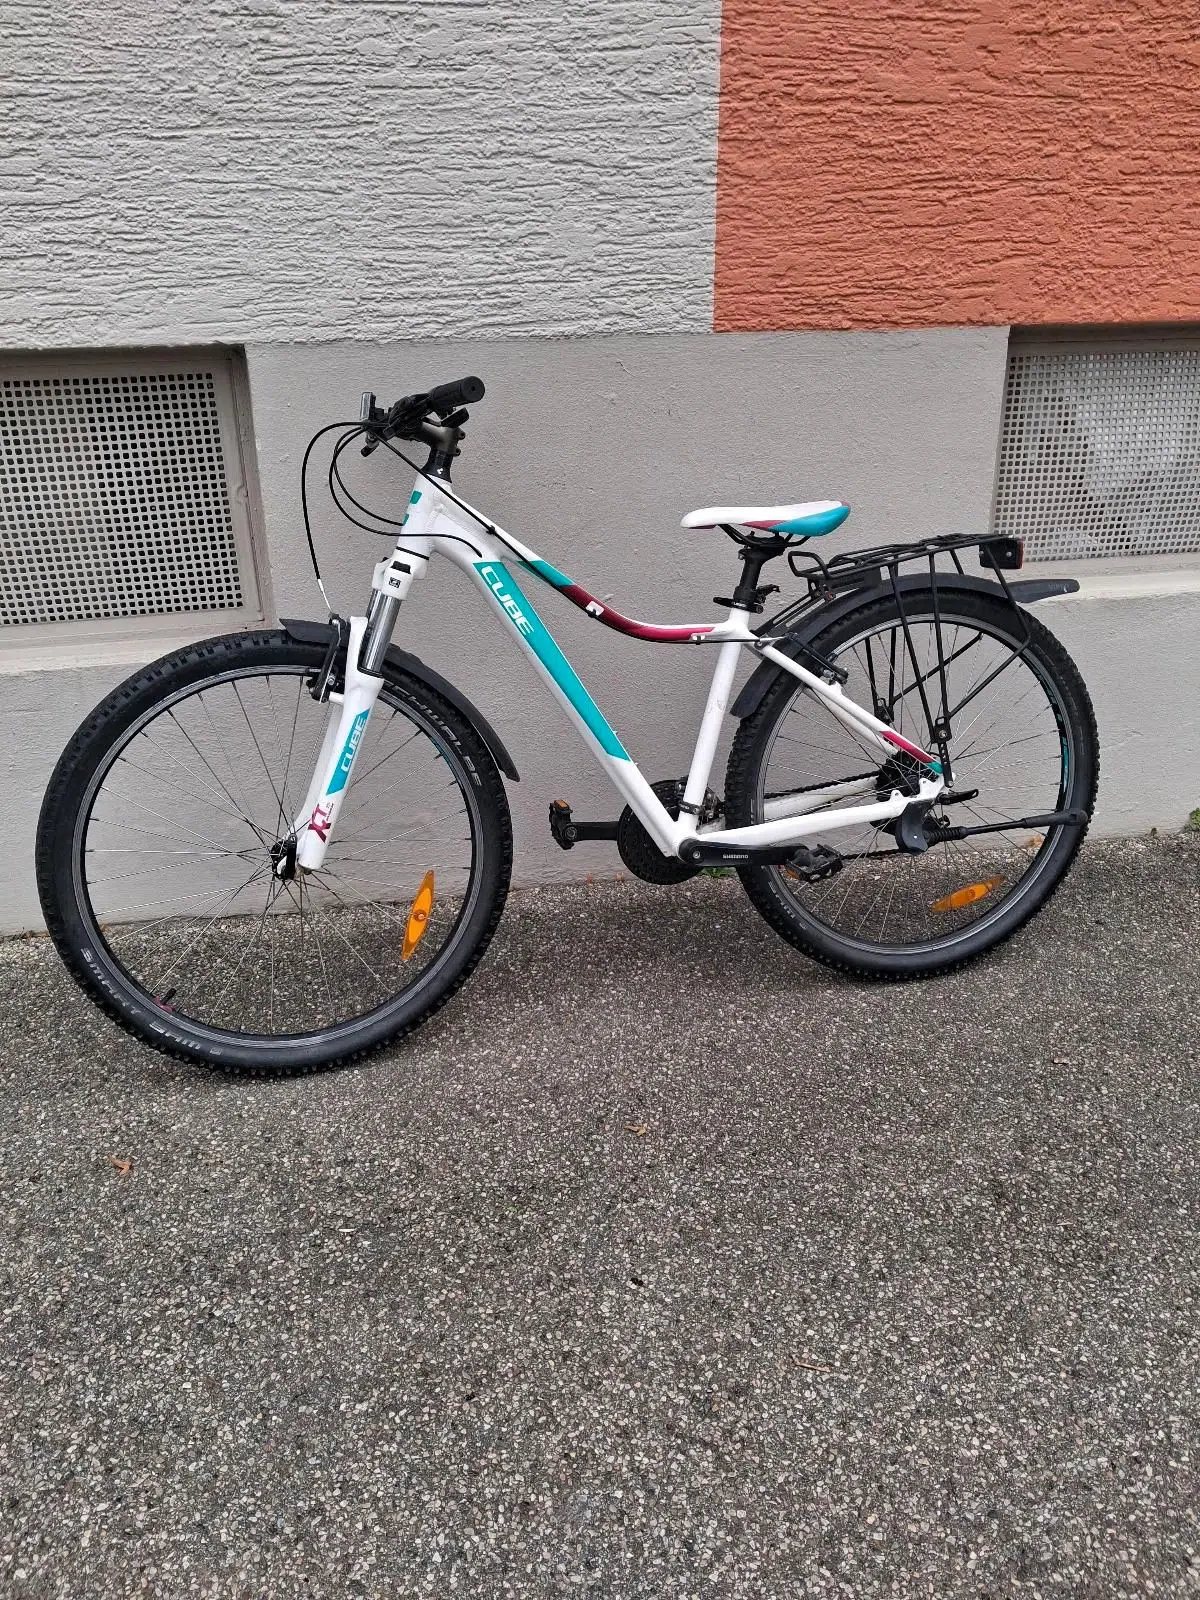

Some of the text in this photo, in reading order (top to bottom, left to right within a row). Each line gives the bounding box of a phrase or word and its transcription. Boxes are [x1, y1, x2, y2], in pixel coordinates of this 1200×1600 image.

[481, 565, 535, 636] CUBE
[340, 715, 367, 773] CUBE
[383, 679, 483, 787] SCHWALBE
[80, 947, 142, 1015] SMART
